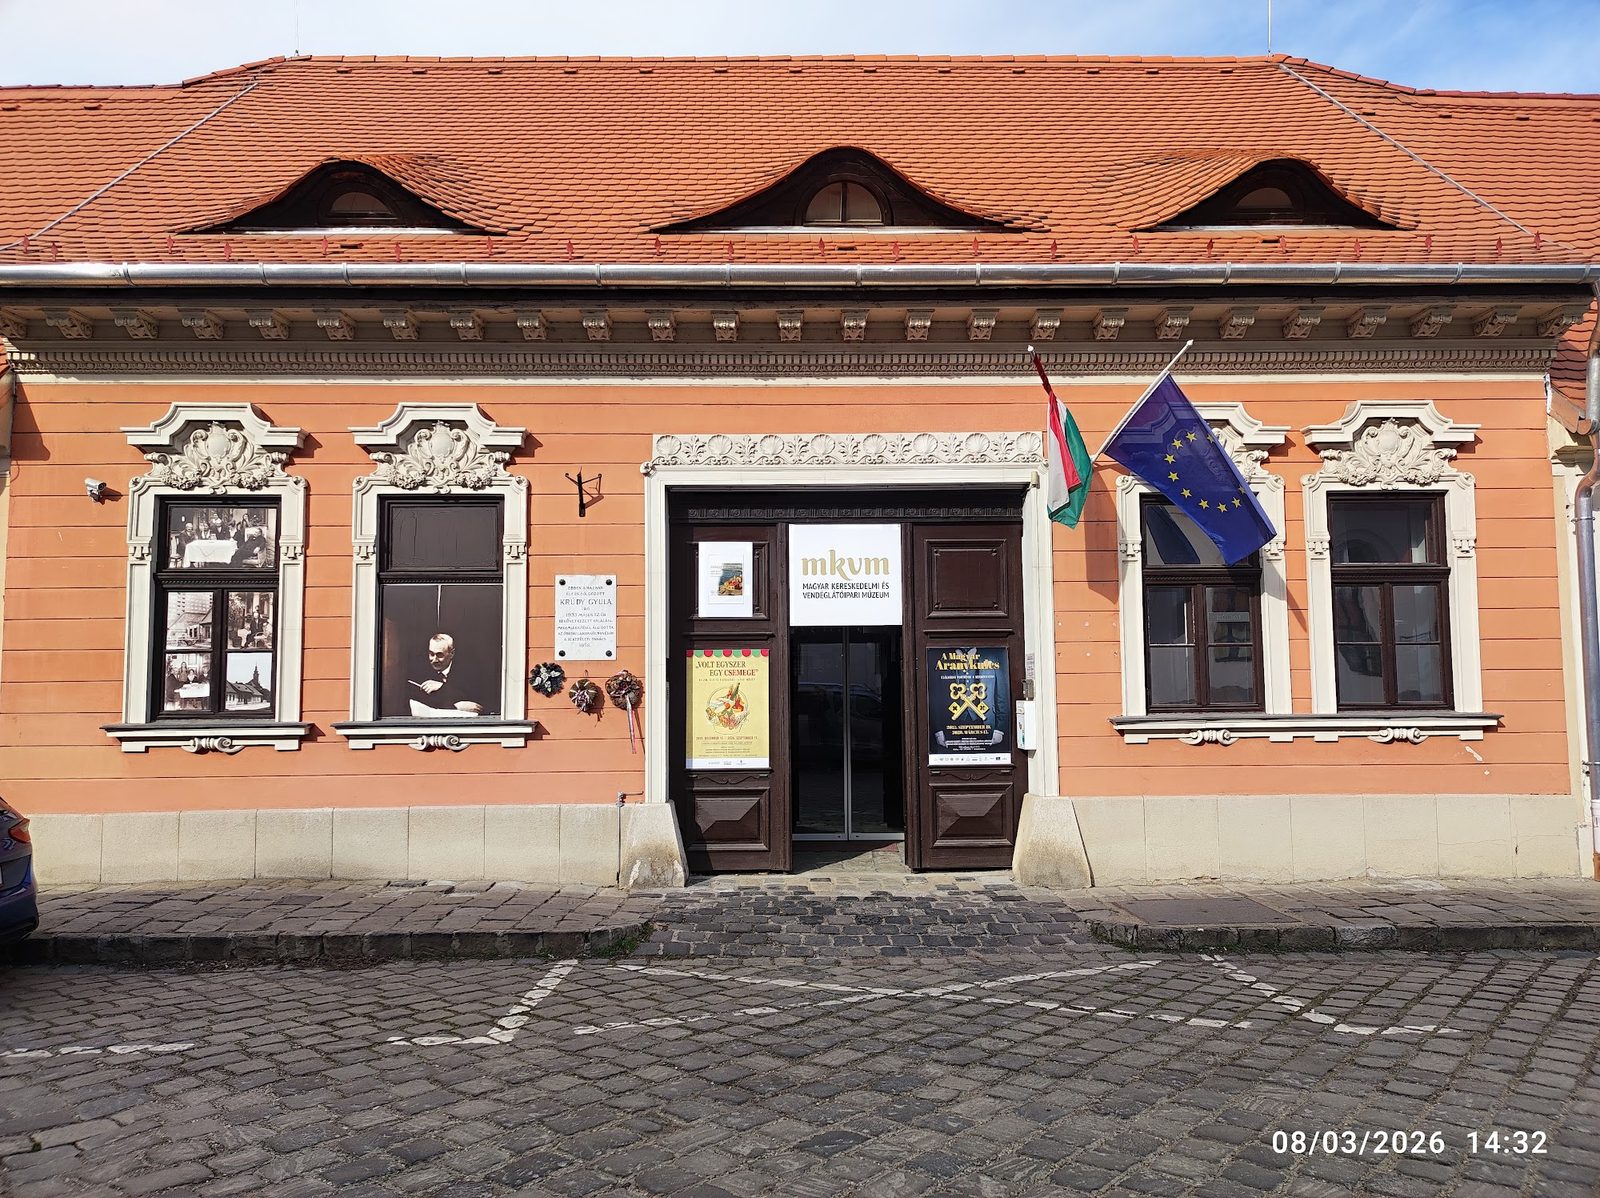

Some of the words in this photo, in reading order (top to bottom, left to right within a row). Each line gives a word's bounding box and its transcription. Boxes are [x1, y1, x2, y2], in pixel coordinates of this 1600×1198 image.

[801, 549, 890, 581] mkvm
[802, 582, 829, 590] MAGYAR
[831, 582, 880, 590] KERESKEDELMI
[881, 581, 890, 590] ÉS
[802, 591, 860, 599] VENDÉGLÁTÓIPARI
[861, 591, 890, 599] MÚZEUM
[560, 597, 585, 605] KRÚDY
[949, 652, 980, 662] Magyar
[716, 660, 746, 669] EGYSZER
[709, 669, 723, 677] EGY
